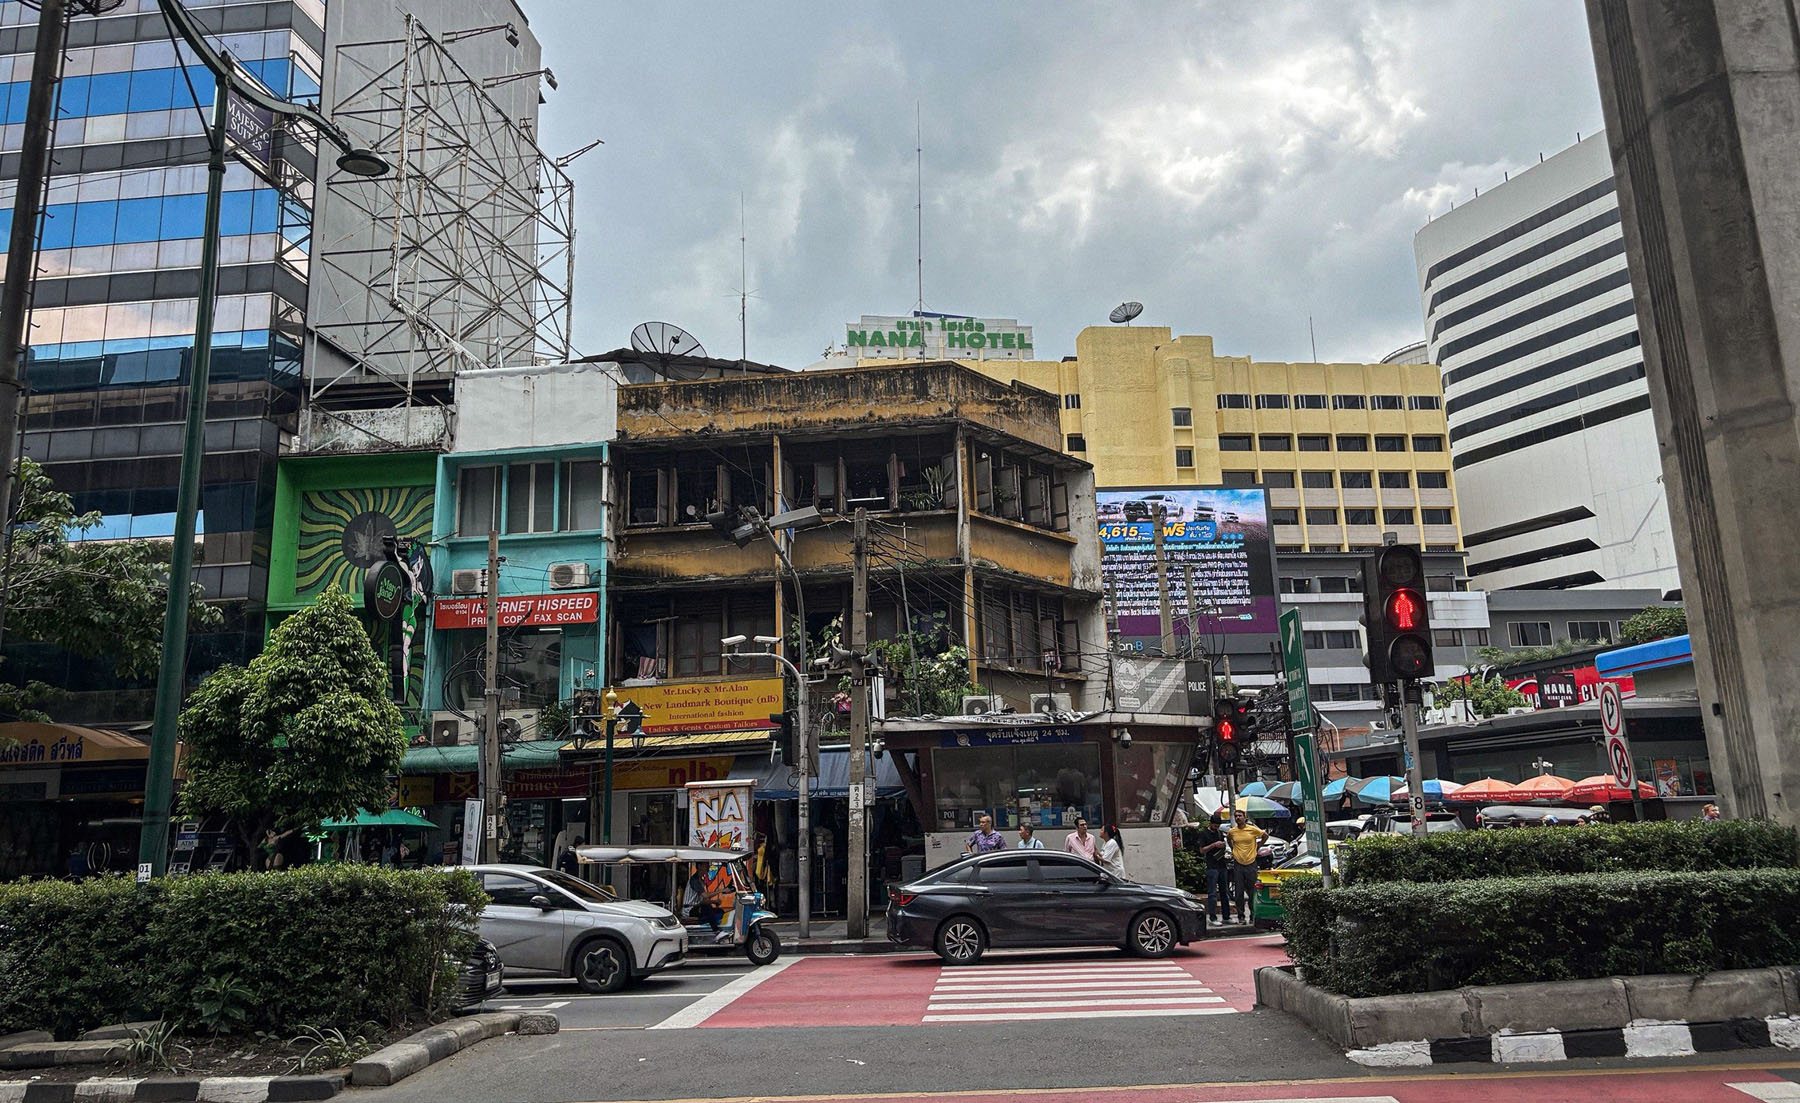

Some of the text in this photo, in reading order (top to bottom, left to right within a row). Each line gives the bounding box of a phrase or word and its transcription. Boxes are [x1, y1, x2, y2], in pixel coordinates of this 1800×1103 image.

[848, 330, 1032, 349] NANA HOTEL
[537, 598, 593, 611] HISPEED
[534, 614, 552, 622] FAX
[556, 612, 583, 621] SCAN
[663, 684, 749, 696] Mr.Lucky & Mr.Alan
[1188, 681, 1207, 692] POLICE
[1543, 683, 1573, 694] NANA
[643, 694, 780, 710] New Landmark Boutique (nlb)
[669, 709, 744, 720] International fashion
[648, 725, 671, 733] Ladies
[681, 723, 702, 731] Gents
[703, 722, 731, 730] Custom
[734, 720, 758, 728] Tailors
[986, 727, 1039, 743] จุดรับแจ้งเหตุ
[1055, 728, 1070, 737] ชม.
[1414, 796, 1423, 810] 8
[140, 865, 149, 873] 01
